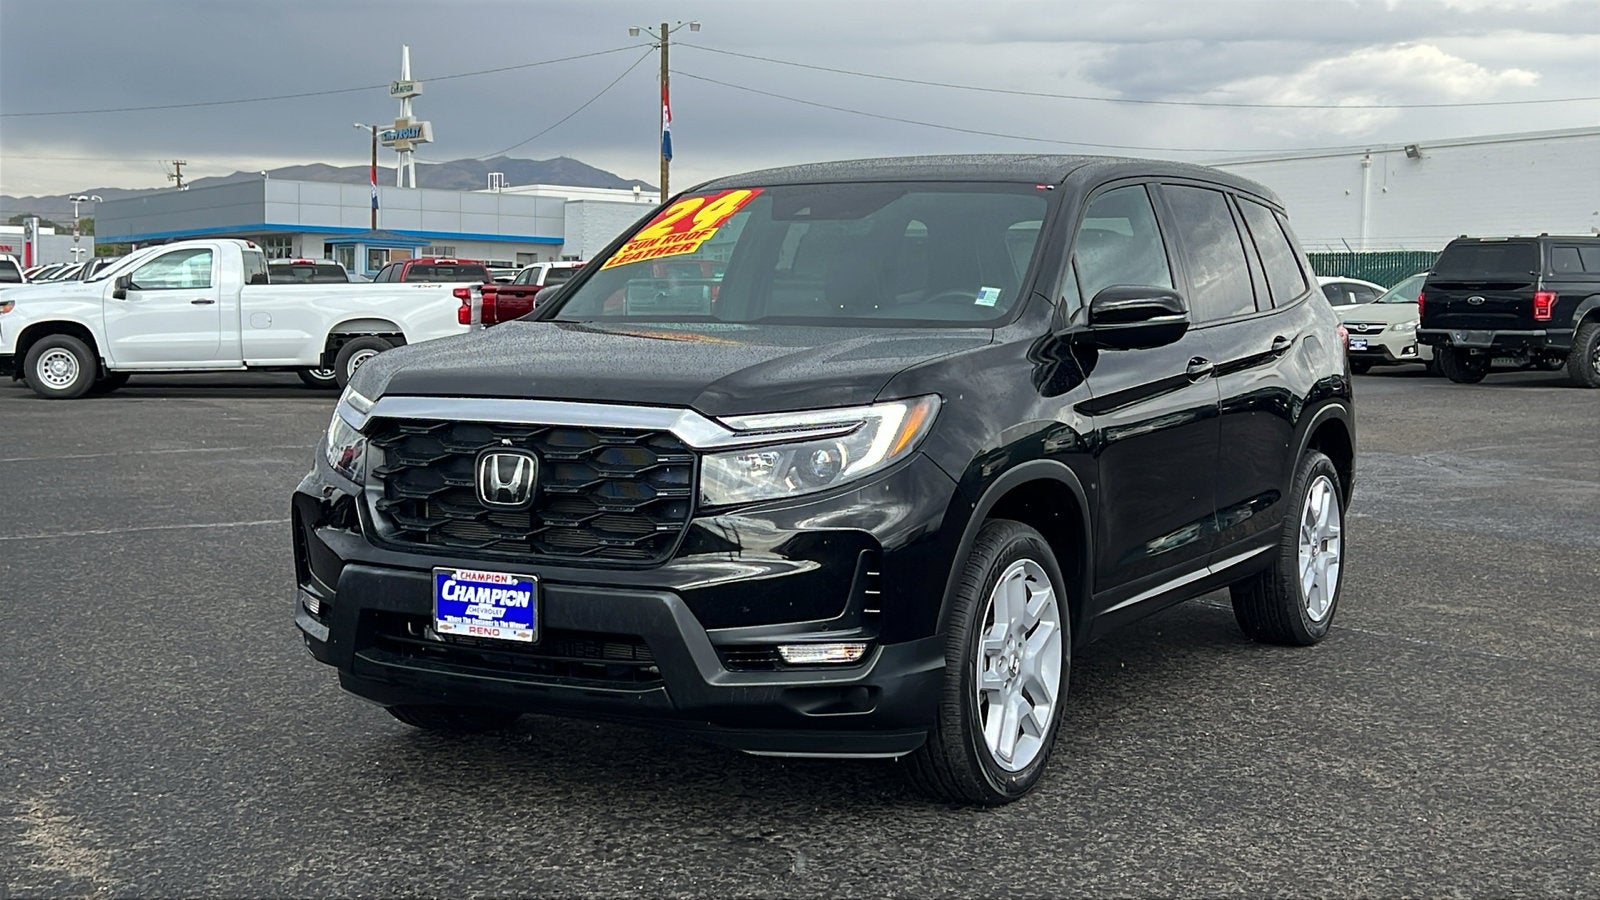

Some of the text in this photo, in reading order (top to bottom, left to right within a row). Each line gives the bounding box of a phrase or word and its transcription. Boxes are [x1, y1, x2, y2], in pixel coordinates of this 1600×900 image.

[635, 189, 752, 241] 24
[624, 230, 713, 253] SUN ROOF
[606, 243, 697, 267] LEATHER
[460, 571, 508, 583] CHAMPION
[441, 579, 531, 608] CHAMPION
[468, 606, 503, 615] CHEVROLET
[469, 626, 500, 636] RENO
